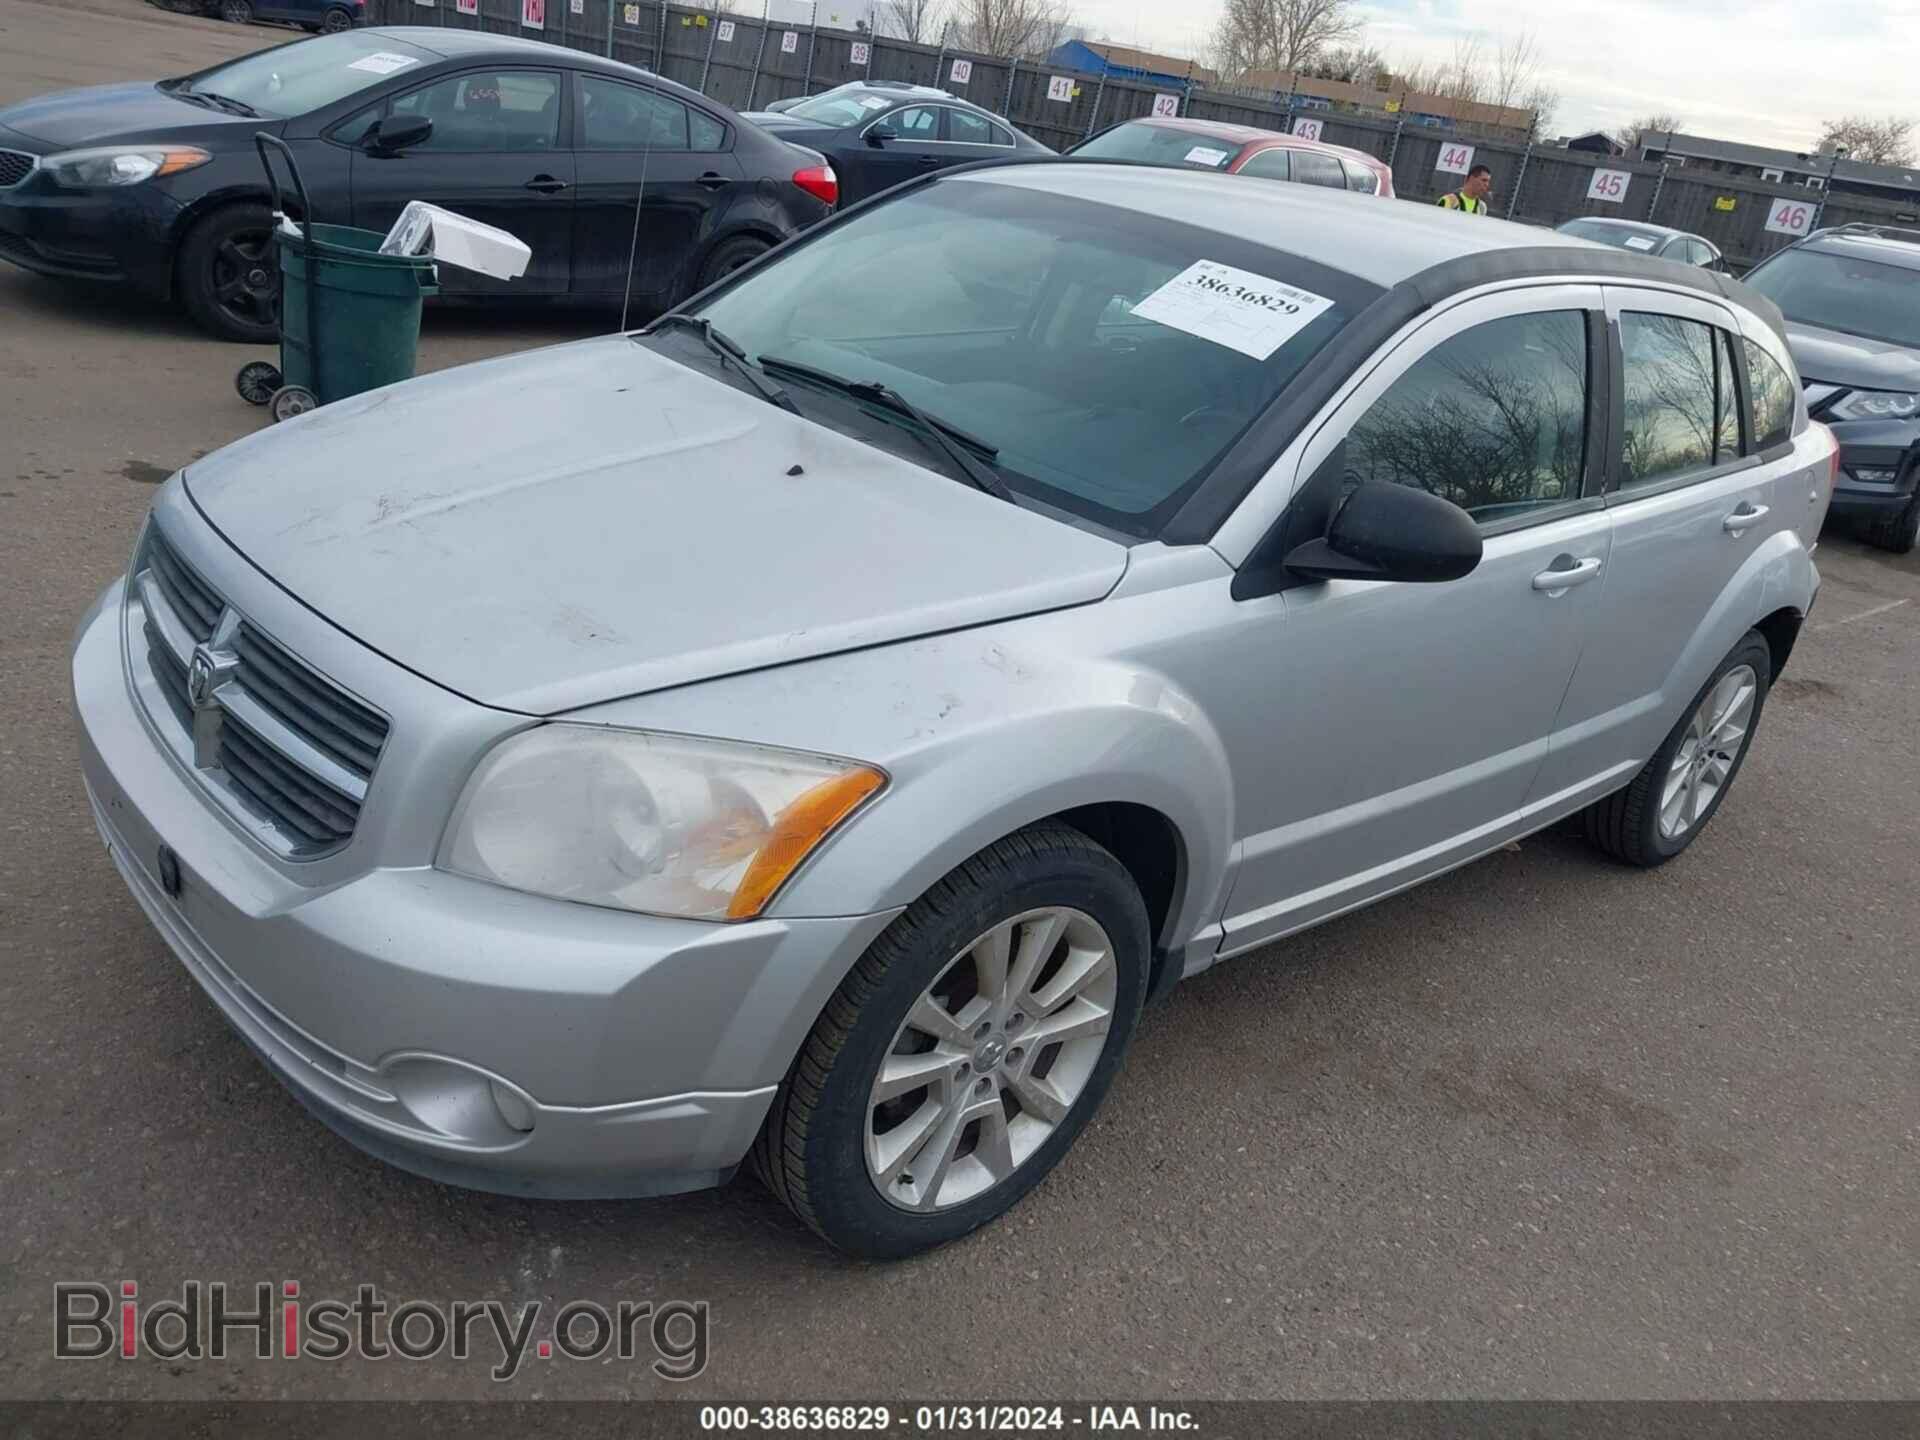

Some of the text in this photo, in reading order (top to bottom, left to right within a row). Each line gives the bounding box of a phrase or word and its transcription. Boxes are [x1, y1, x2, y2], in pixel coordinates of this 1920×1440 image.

[720, 25, 733, 38] 37
[783, 35, 796, 49] 38
[853, 45, 866, 61] 39
[955, 63, 967, 79] 40
[1053, 81, 1069, 97] 41
[1157, 99, 1175, 116] 42
[1297, 122, 1317, 141] 43
[1444, 148, 1467, 169] 44
[1595, 171, 1621, 196] 45
[1775, 206, 1807, 229] 46
[1188, 274, 1300, 315] 38636829
